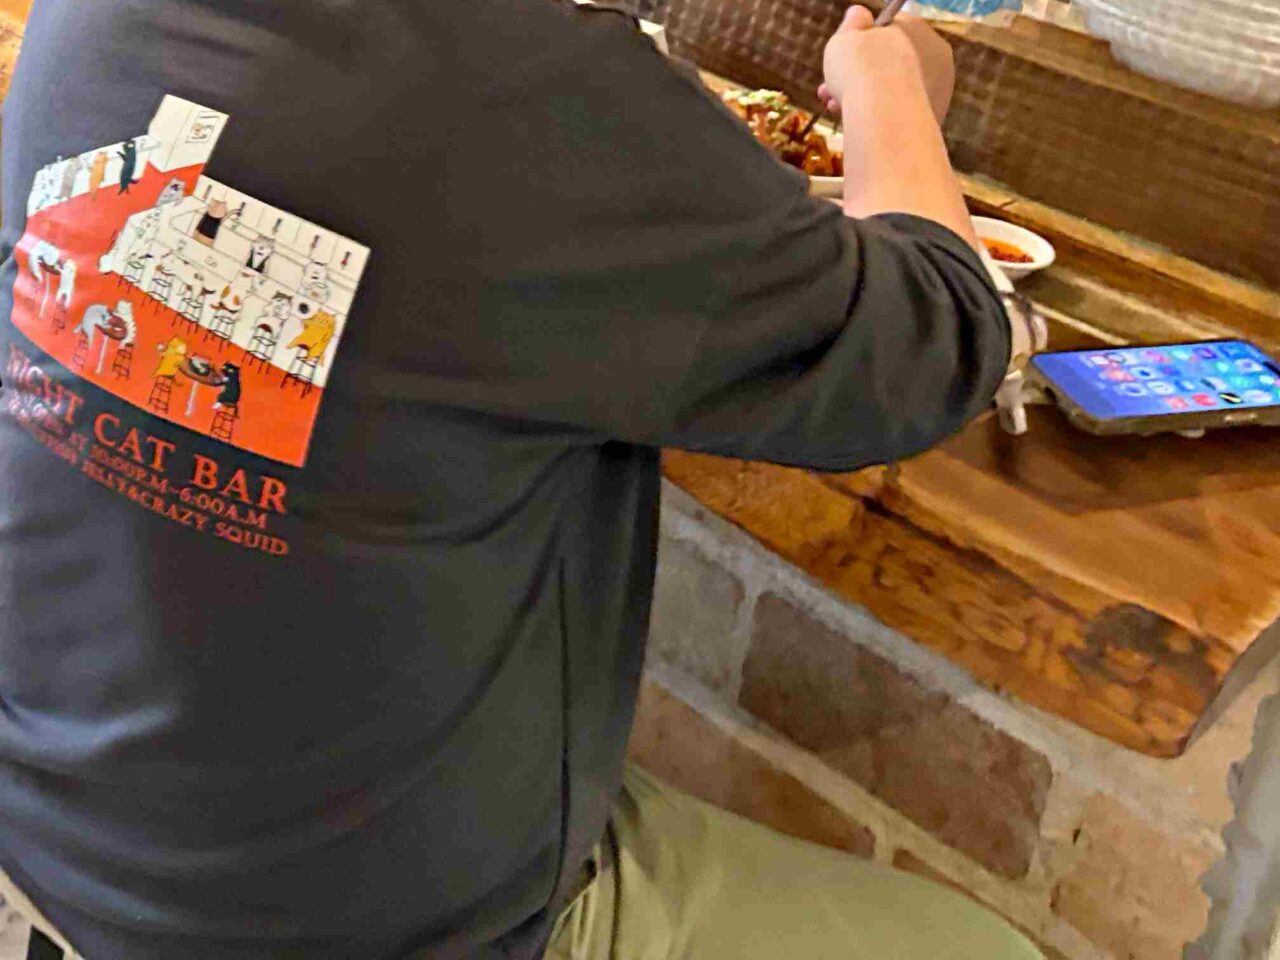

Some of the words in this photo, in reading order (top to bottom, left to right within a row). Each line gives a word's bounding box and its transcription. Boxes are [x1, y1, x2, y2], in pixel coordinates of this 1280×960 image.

[94, 412, 176, 472] CAT
[190, 454, 287, 513] BAR
[215, 521, 289, 555] SQUID
